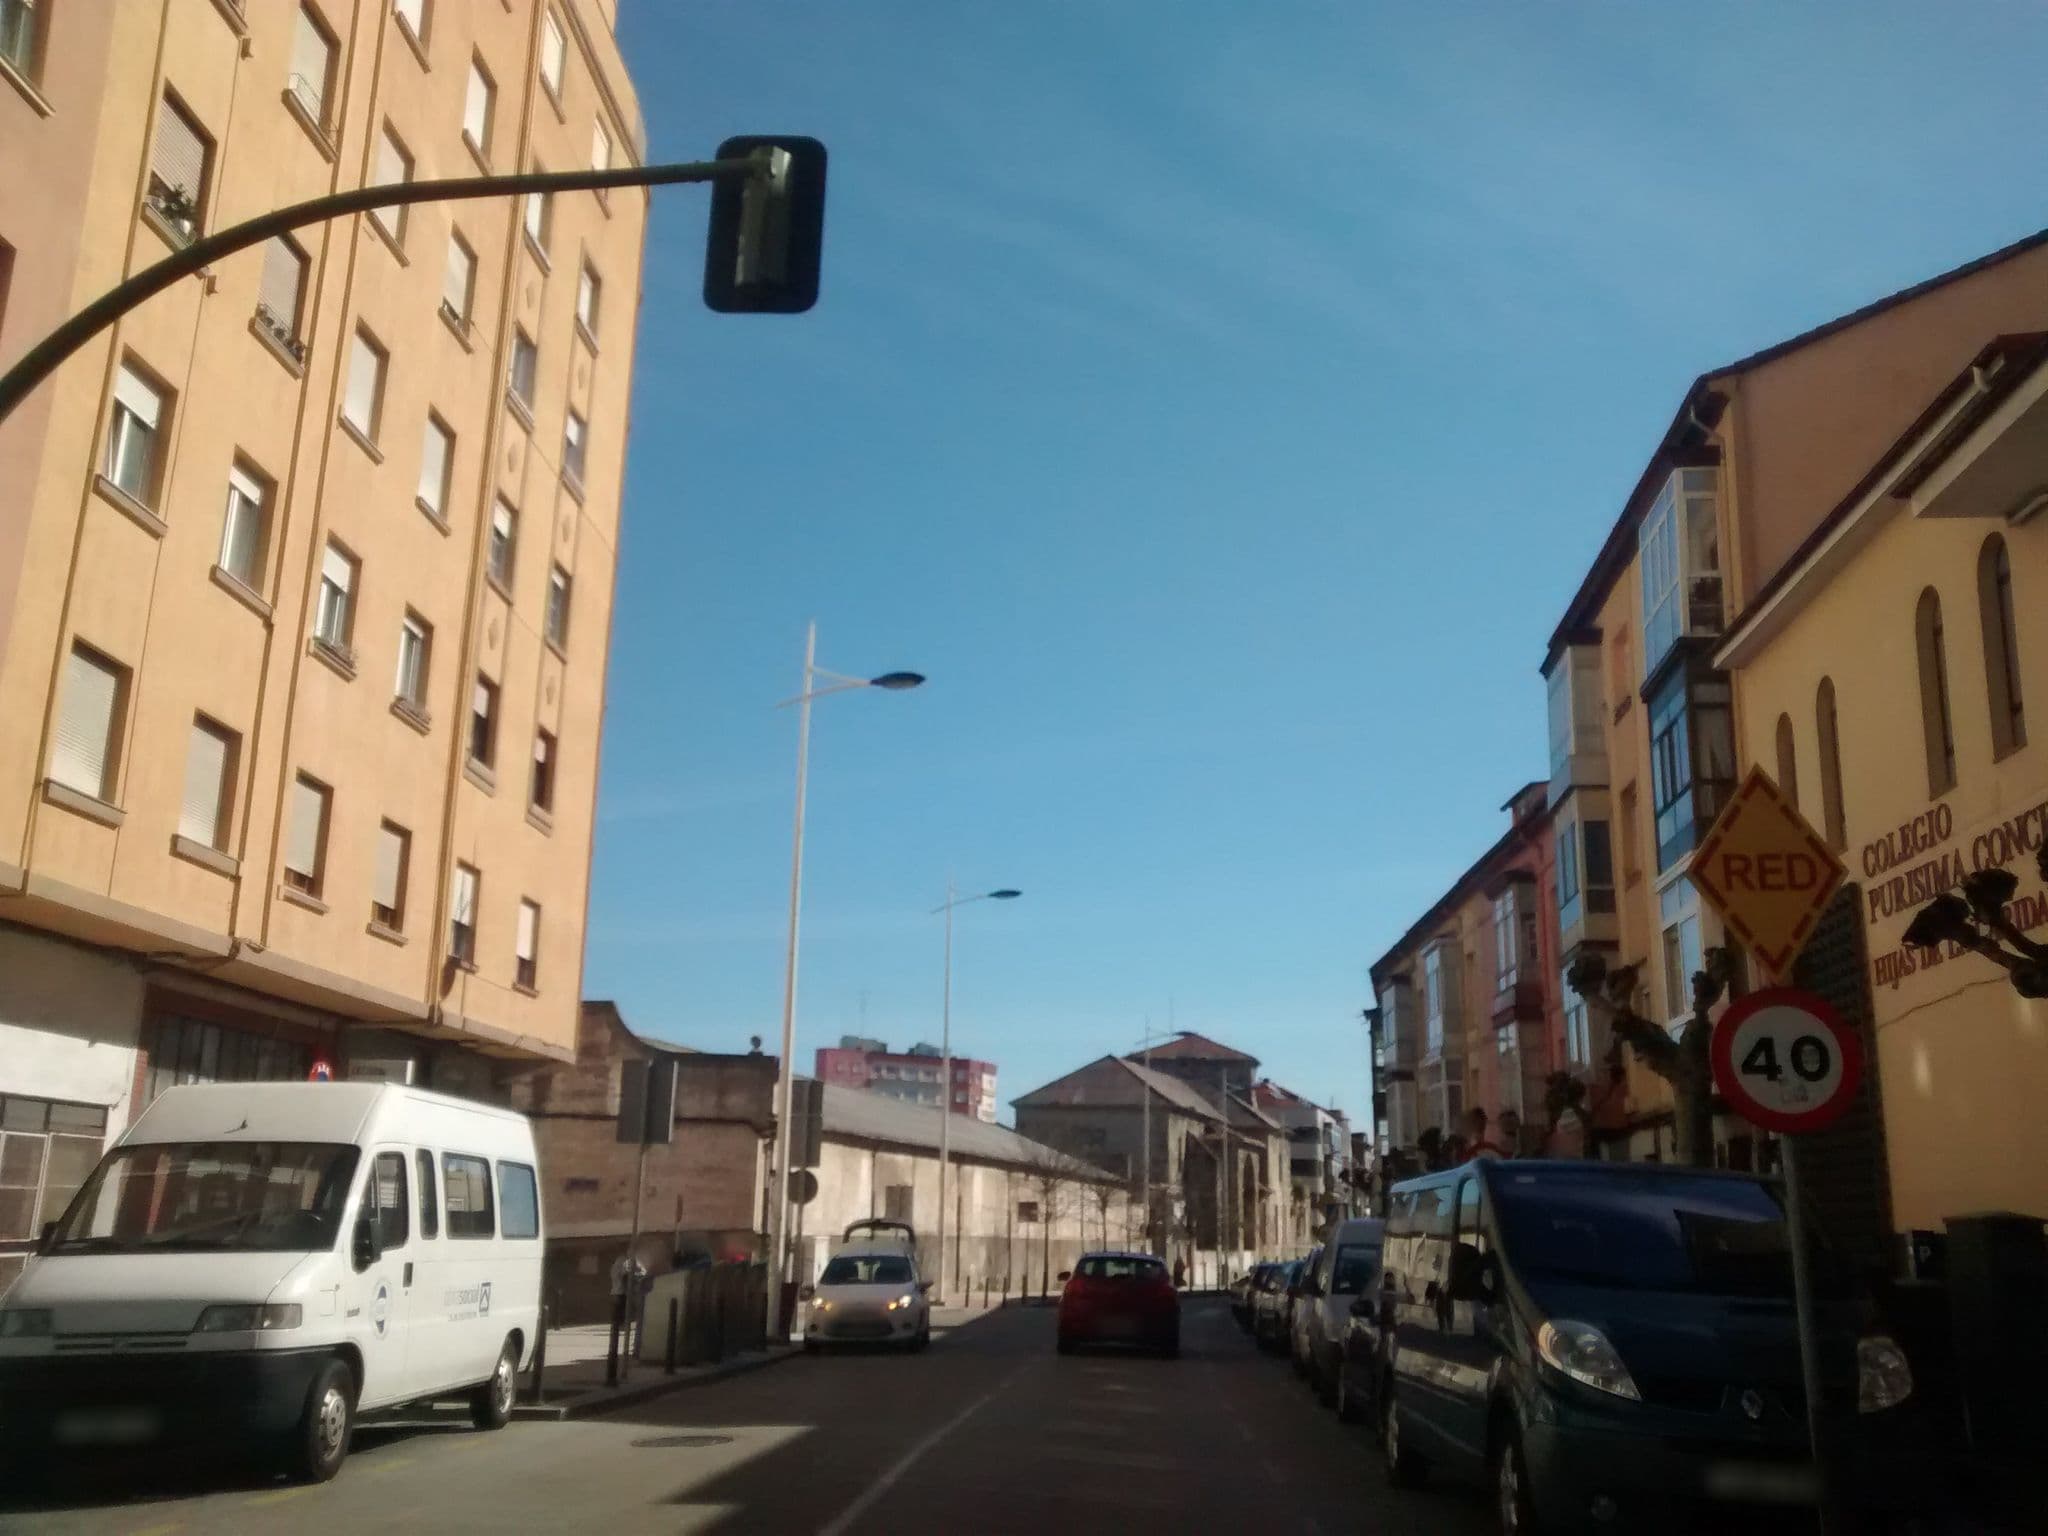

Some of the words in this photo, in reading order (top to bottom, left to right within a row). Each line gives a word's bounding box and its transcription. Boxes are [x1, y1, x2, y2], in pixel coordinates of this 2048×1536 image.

[1863, 803, 1952, 878] COLEGIO
[1723, 853, 1818, 891] RED
[1868, 848, 1968, 925] PURISIMA
[1741, 1035, 1831, 1082] 40
